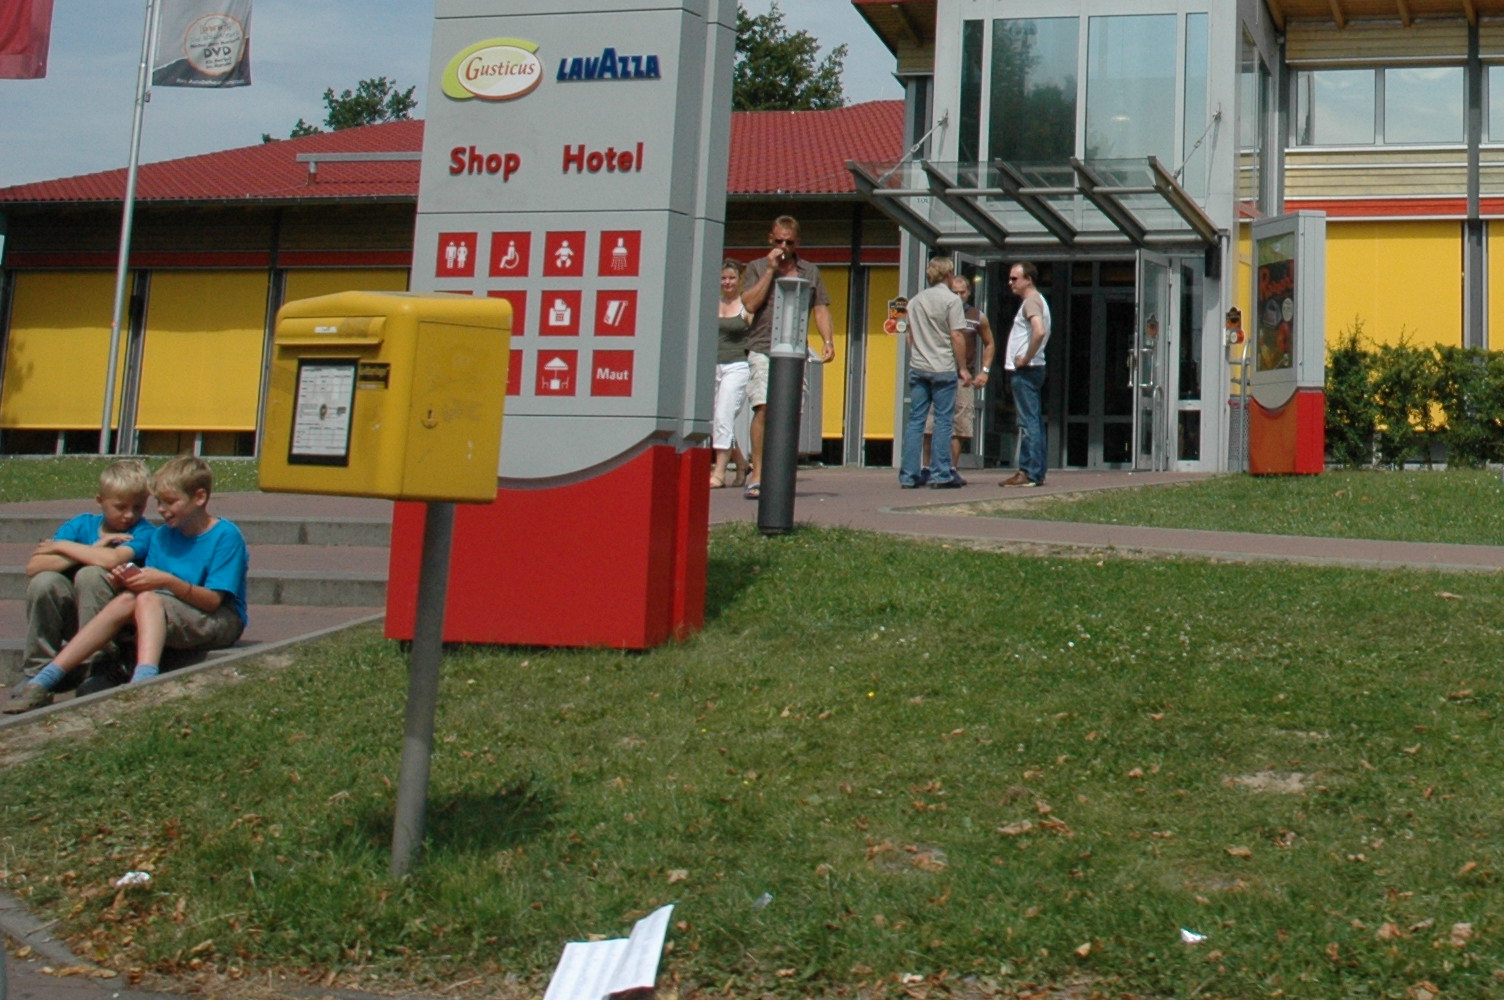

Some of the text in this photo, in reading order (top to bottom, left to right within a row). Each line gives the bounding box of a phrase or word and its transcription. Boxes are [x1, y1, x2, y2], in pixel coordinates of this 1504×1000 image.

[203, 46, 232, 59] DVD
[556, 48, 662, 82] LAVAZZA
[465, 56, 536, 81] Gusticus
[449, 145, 522, 183] Shop
[562, 142, 644, 174] Hotel
[596, 367, 629, 381] Maut
